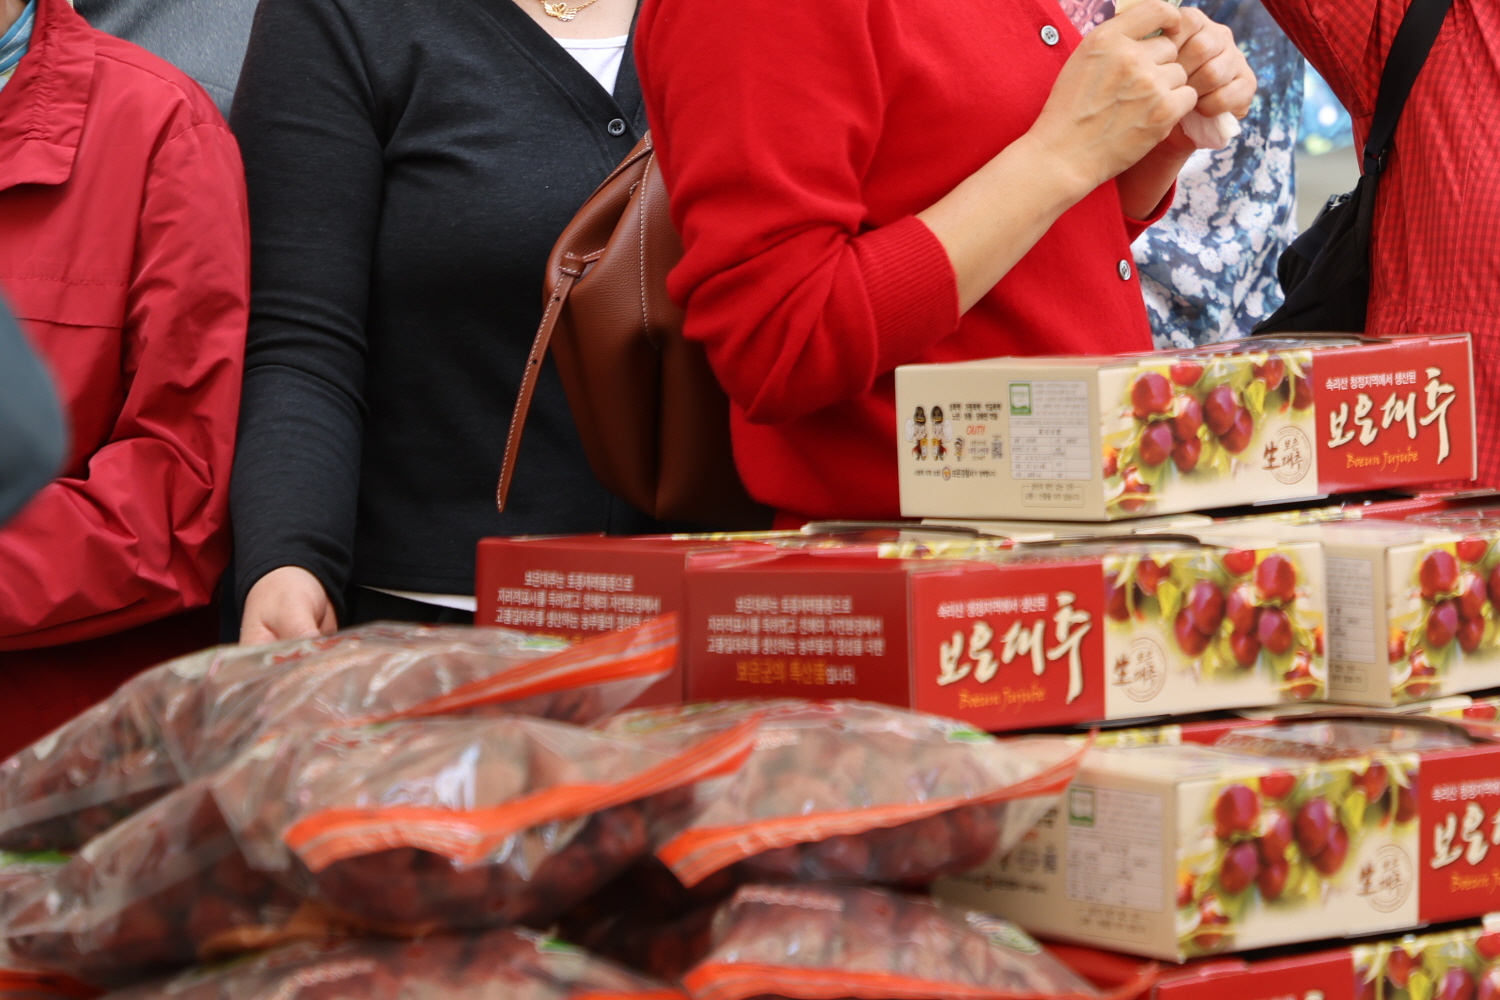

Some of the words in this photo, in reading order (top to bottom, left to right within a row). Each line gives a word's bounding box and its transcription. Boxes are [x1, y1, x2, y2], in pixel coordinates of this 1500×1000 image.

[1325, 378, 1348, 391] 속리산
[1350, 373, 1393, 389] 청정지역에서
[1394, 371, 1417, 385] 생산된
[1328, 367, 1456, 465] 보은대추
[1262, 440, 1280, 470] 生
[1284, 439, 1299, 452] 보은
[1346, 453, 1380, 469] Boeun
[1380, 447, 1419, 473] Jujube
[524, 571, 565, 589] 보은대추는
[497, 589, 546, 608] 지리적표시를
[937, 602, 964, 619] 속리산
[966, 597, 1019, 617] 청정지역에서
[1021, 593, 1048, 613] 생산된
[495, 608, 544, 627] 고품질대추를
[546, 611, 579, 629] 생산하는
[581, 613, 612, 630] 농부들의
[936, 591, 1092, 705] 보은대추
[736, 661, 784, 684] 보은군의
[1431, 782, 1458, 802] 속리산
